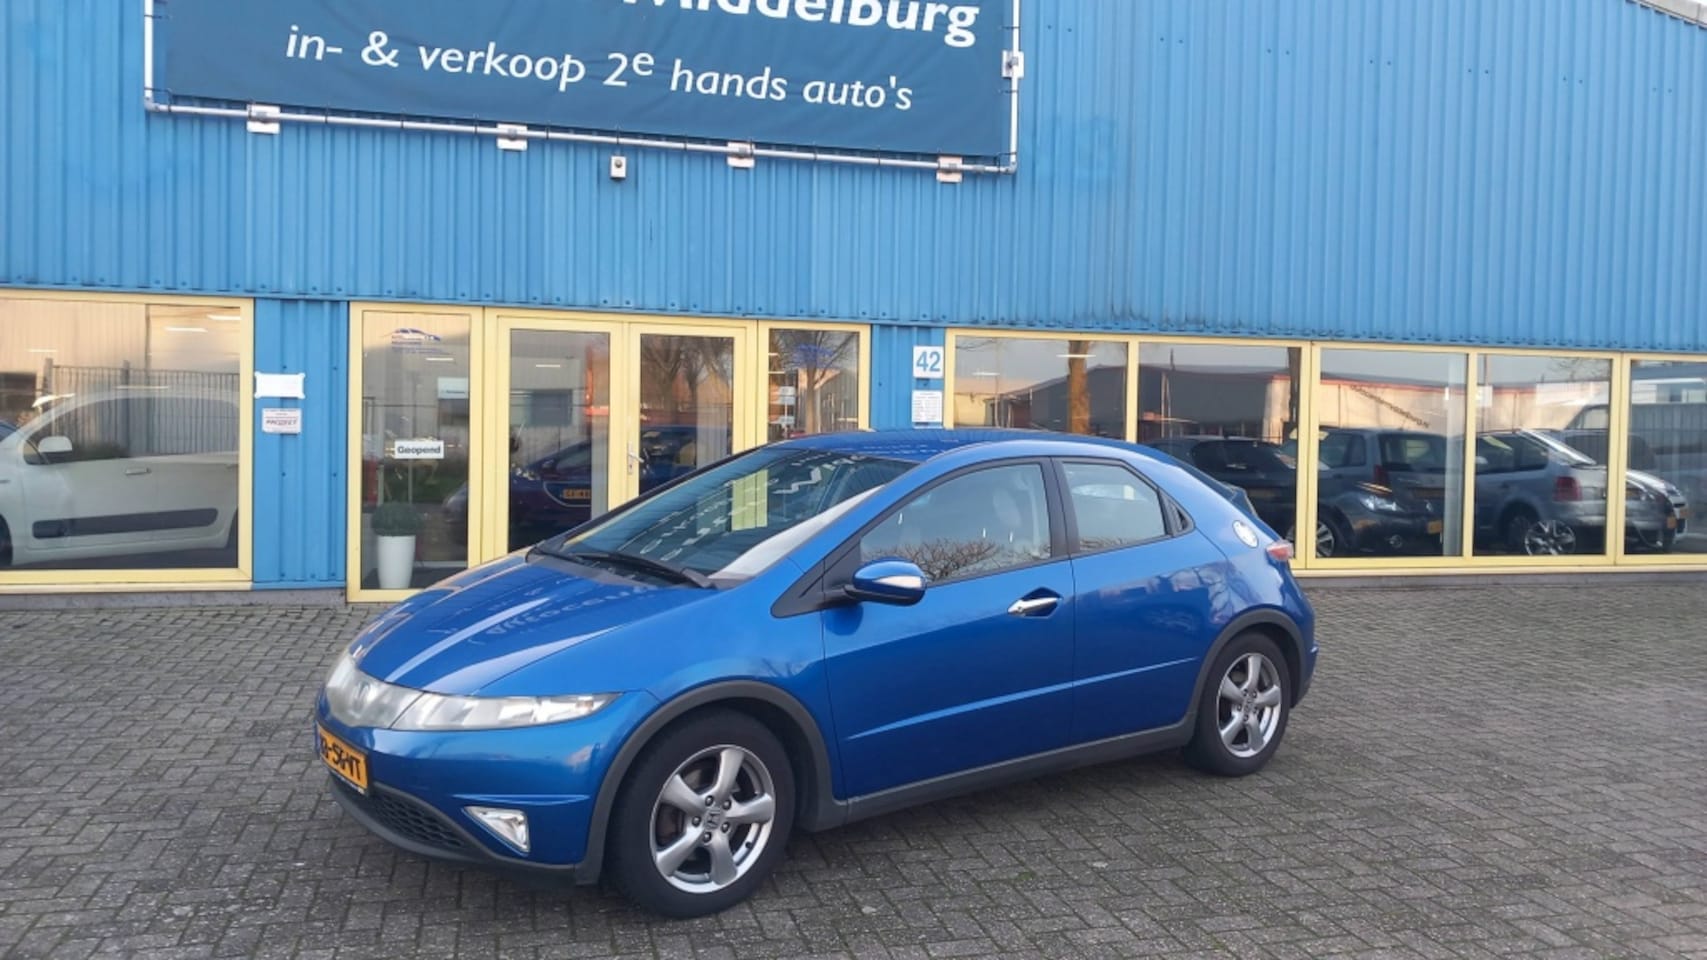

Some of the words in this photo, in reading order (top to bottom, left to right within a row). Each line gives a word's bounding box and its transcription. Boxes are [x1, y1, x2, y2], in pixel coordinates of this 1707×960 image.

[623, 0, 980, 48] elburg
[286, 25, 343, 60] in-
[361, 31, 399, 67] &
[419, 41, 586, 92] verkoop
[670, 58, 787, 101] hands
[803, 75, 913, 110] auto's
[916, 351, 941, 372] 42
[397, 445, 441, 455] Geopend
